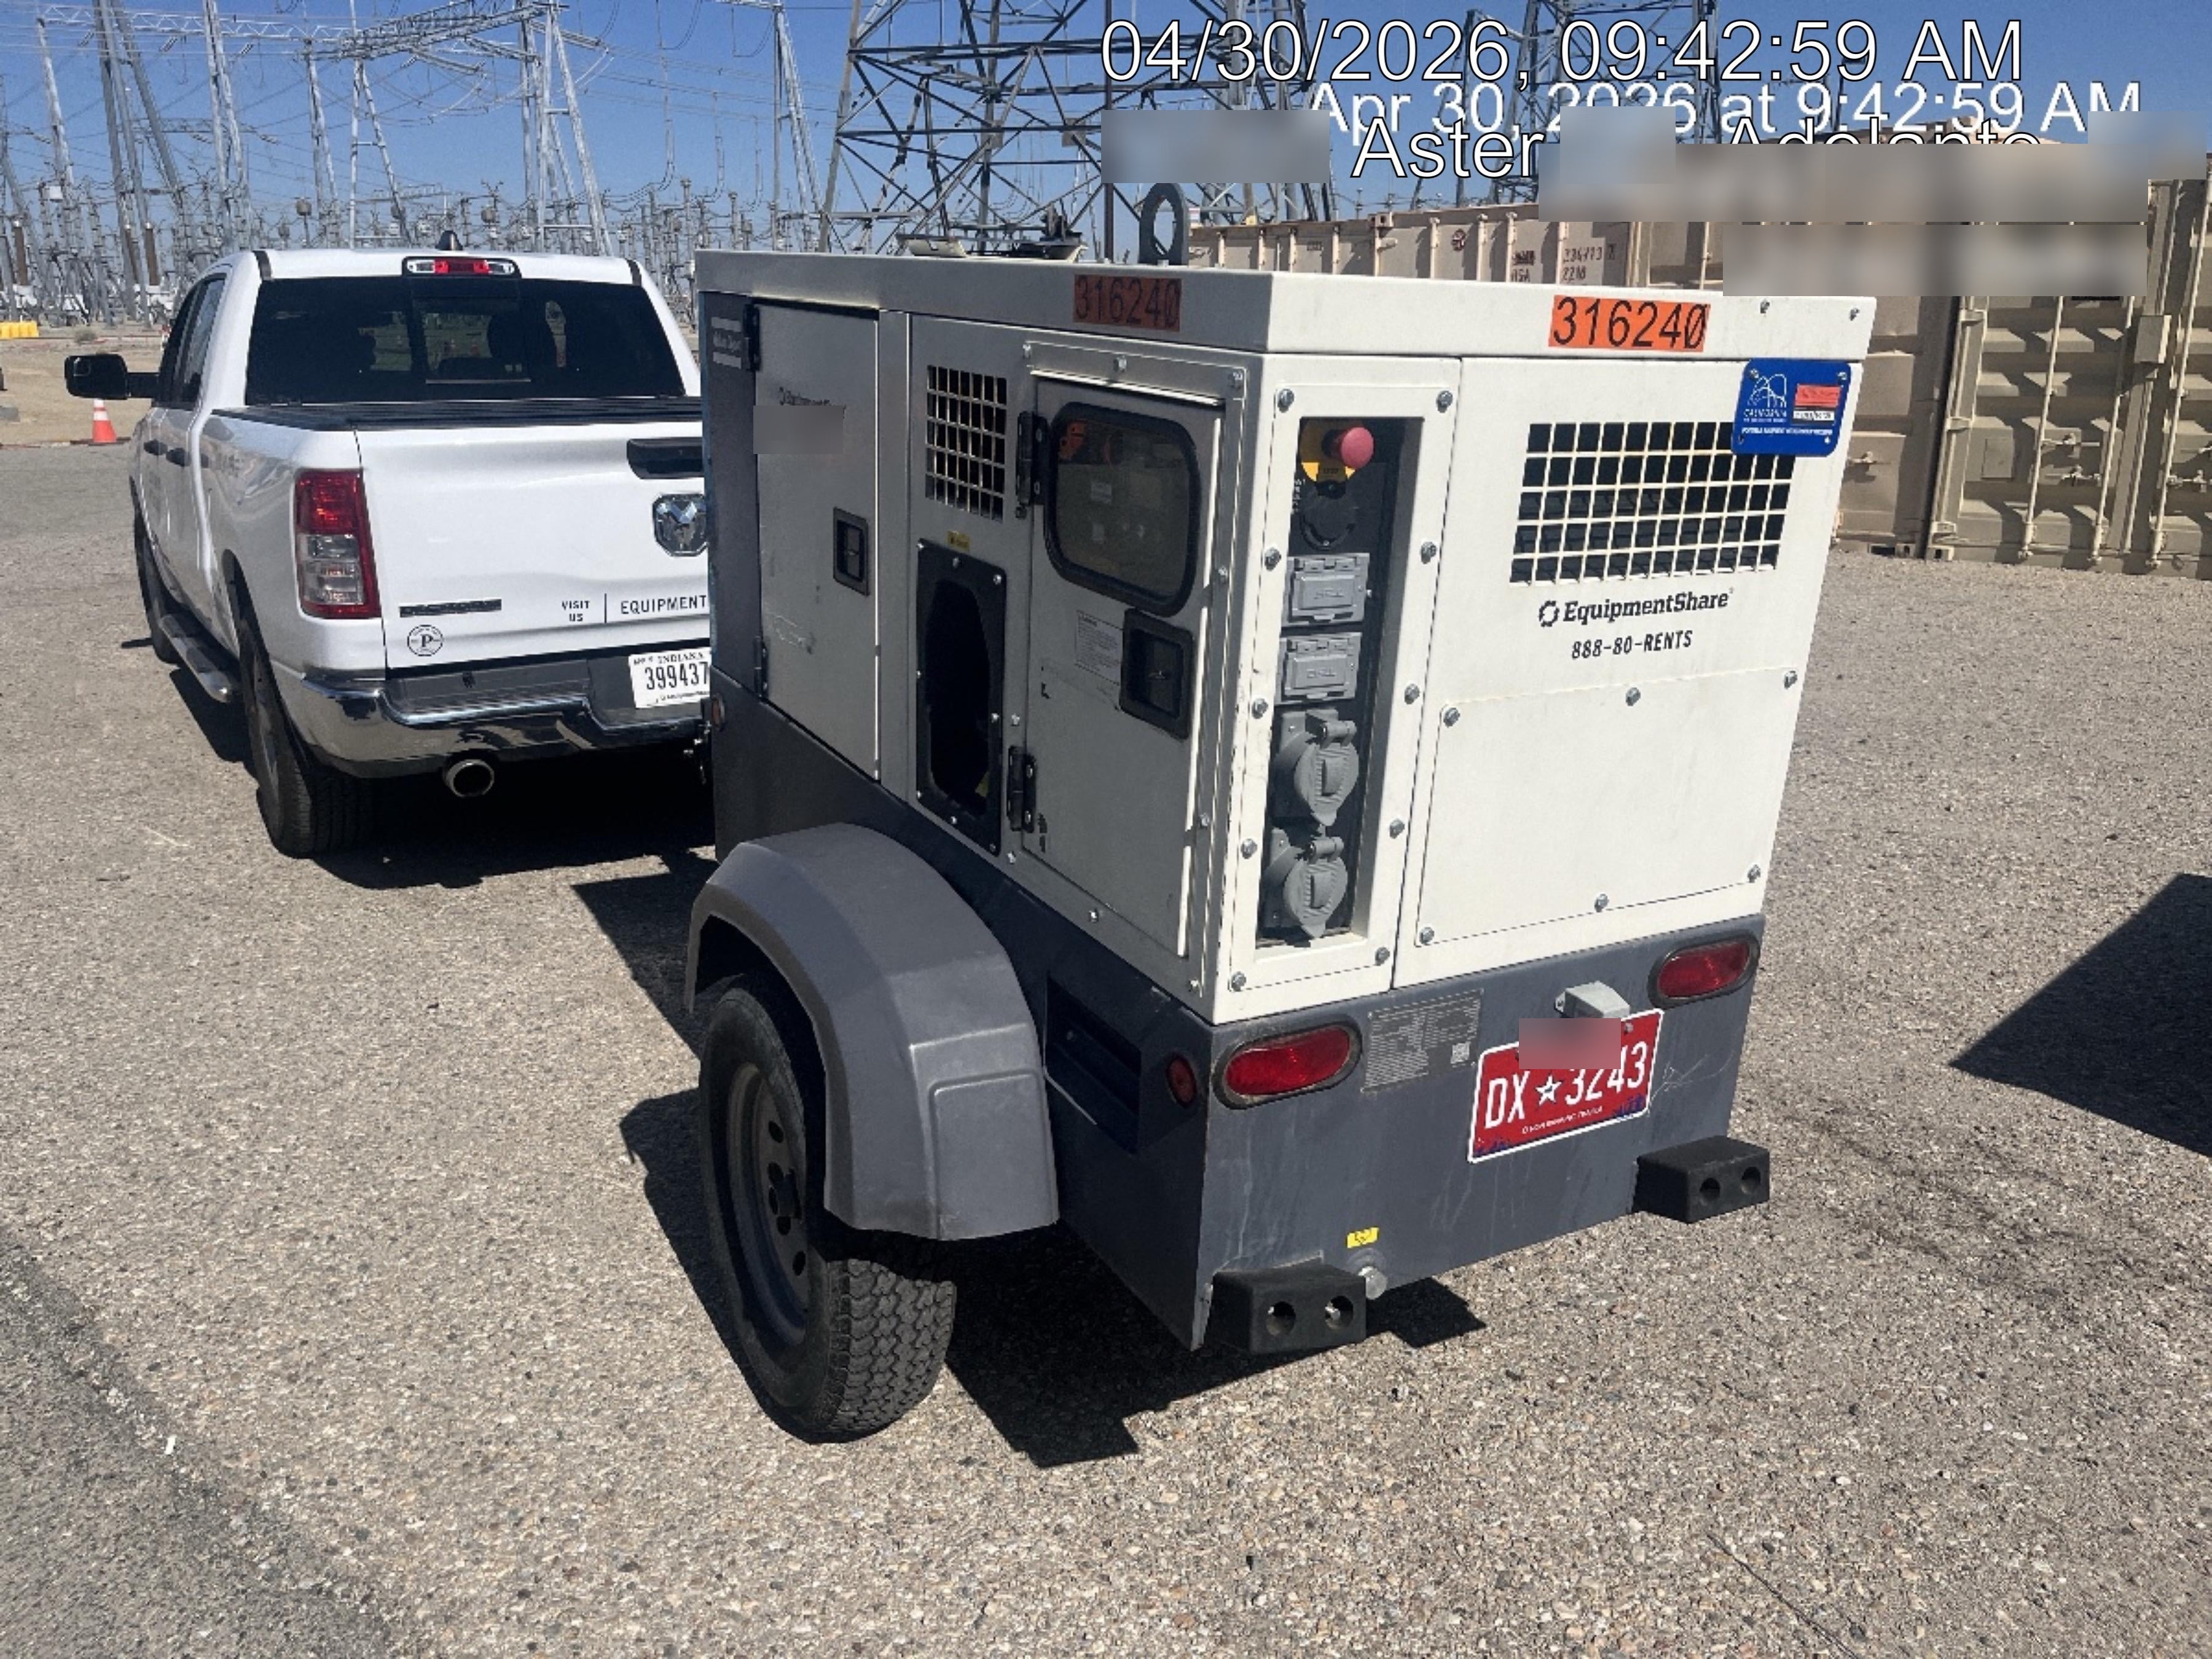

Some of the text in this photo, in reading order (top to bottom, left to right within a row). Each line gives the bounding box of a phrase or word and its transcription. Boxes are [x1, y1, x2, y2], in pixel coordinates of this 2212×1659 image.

[1075, 275, 1181, 327] 316240
[1553, 296, 1708, 349] 316240
[561, 600, 590, 610] VISIT
[568, 613, 584, 622] US
[621, 595, 707, 614] EQUIPMENT
[1563, 592, 1728, 626] EquipmentShare
[657, 652, 704, 664] INDIANA
[1571, 630, 1693, 661] 888-80-RENTS
[645, 661, 708, 690] 399437
[1484, 1070, 1531, 1129] DX
[1564, 1041, 1648, 1105] 3243
